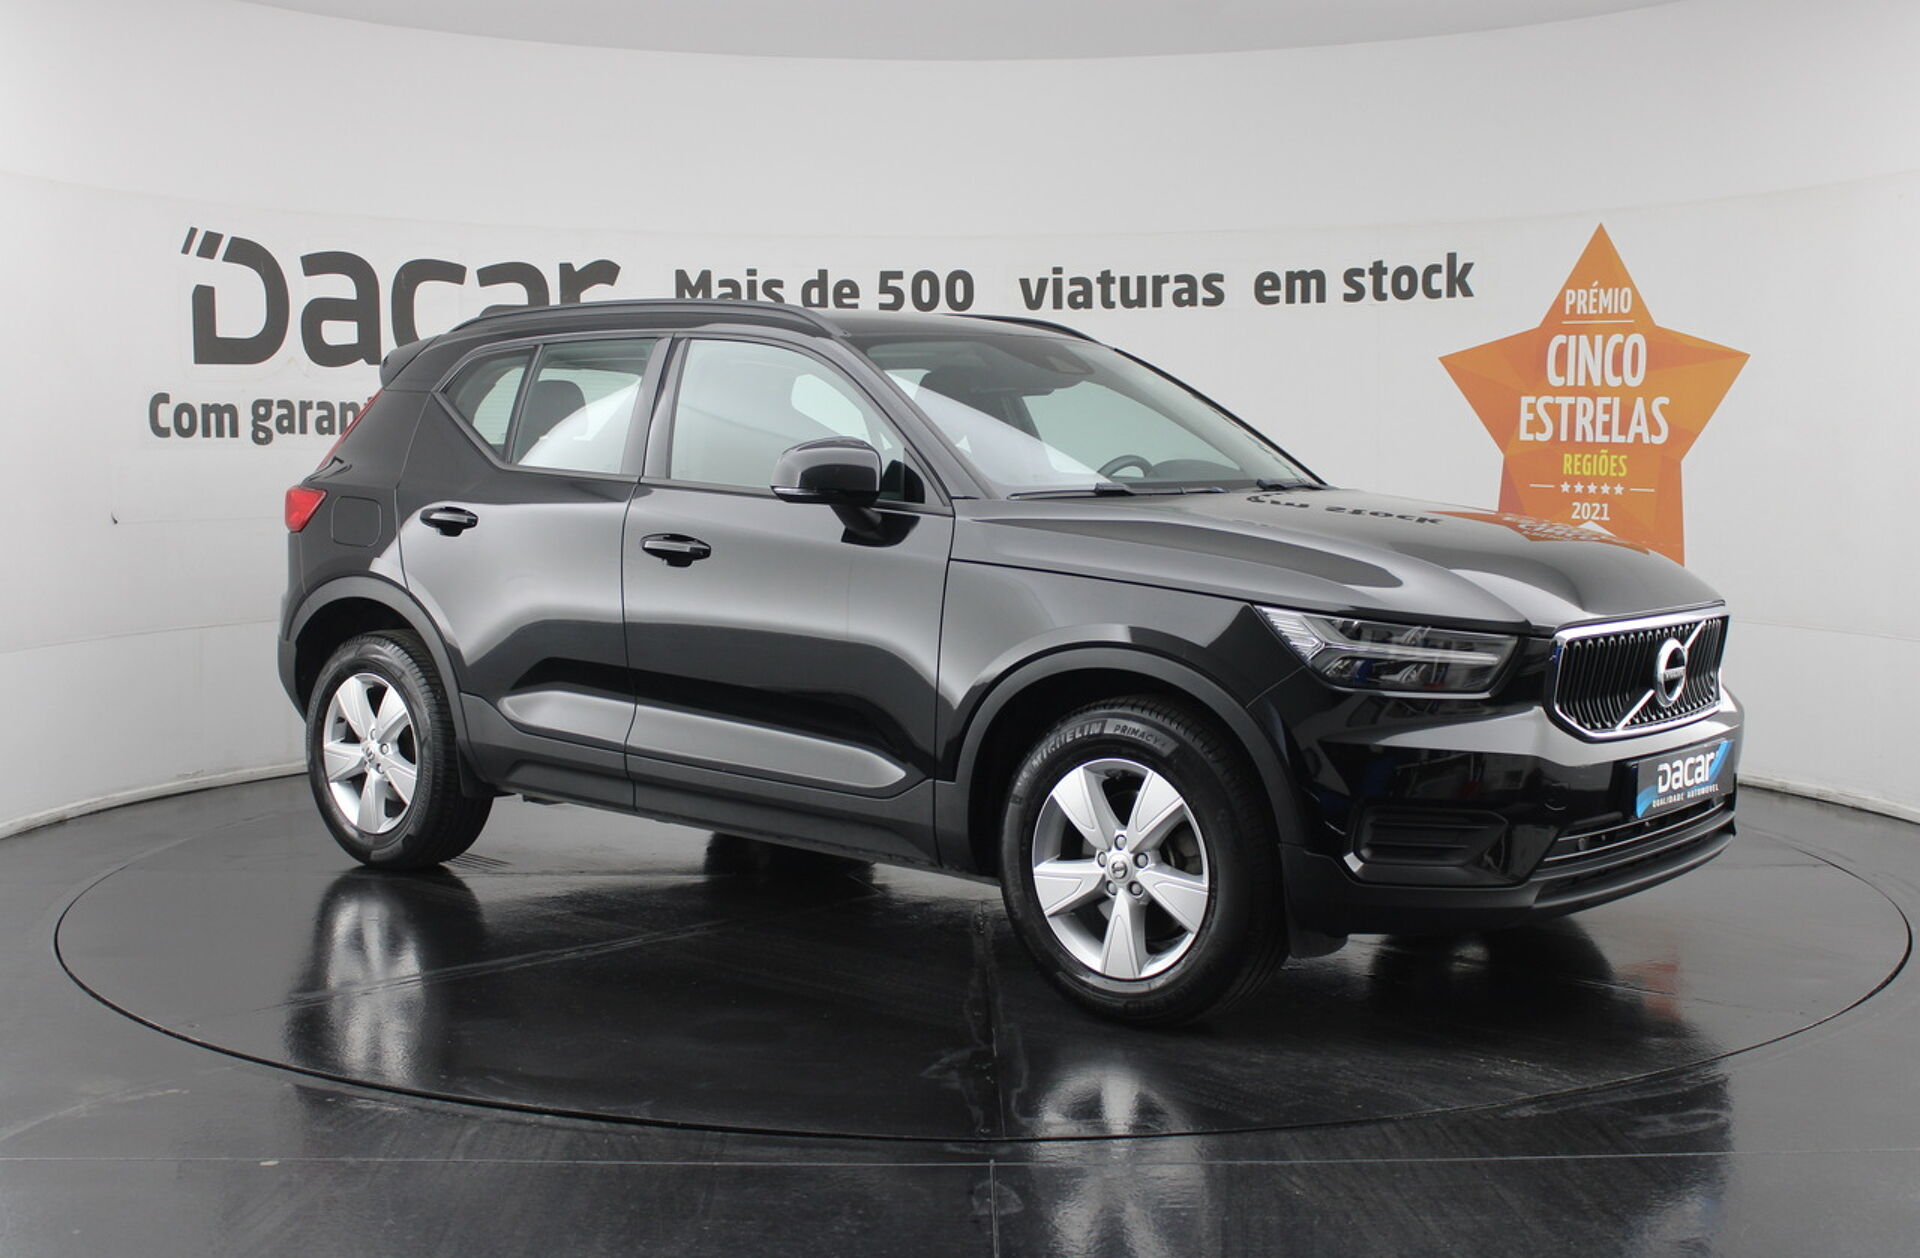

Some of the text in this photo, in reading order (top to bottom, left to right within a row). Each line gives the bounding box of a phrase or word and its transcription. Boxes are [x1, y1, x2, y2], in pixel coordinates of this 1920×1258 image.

[675, 252, 1474, 311] Mais de 500 viaturas em stock
[1564, 281, 1632, 315] PRÉMIO
[1547, 333, 1646, 388] CINCO
[149, 392, 372, 445] Com garan
[1519, 396, 1670, 444] ESTRELAS
[1562, 449, 1628, 477] REGIÕES
[1571, 502, 1611, 521] 2021
[1657, 752, 1716, 794] Dacar
